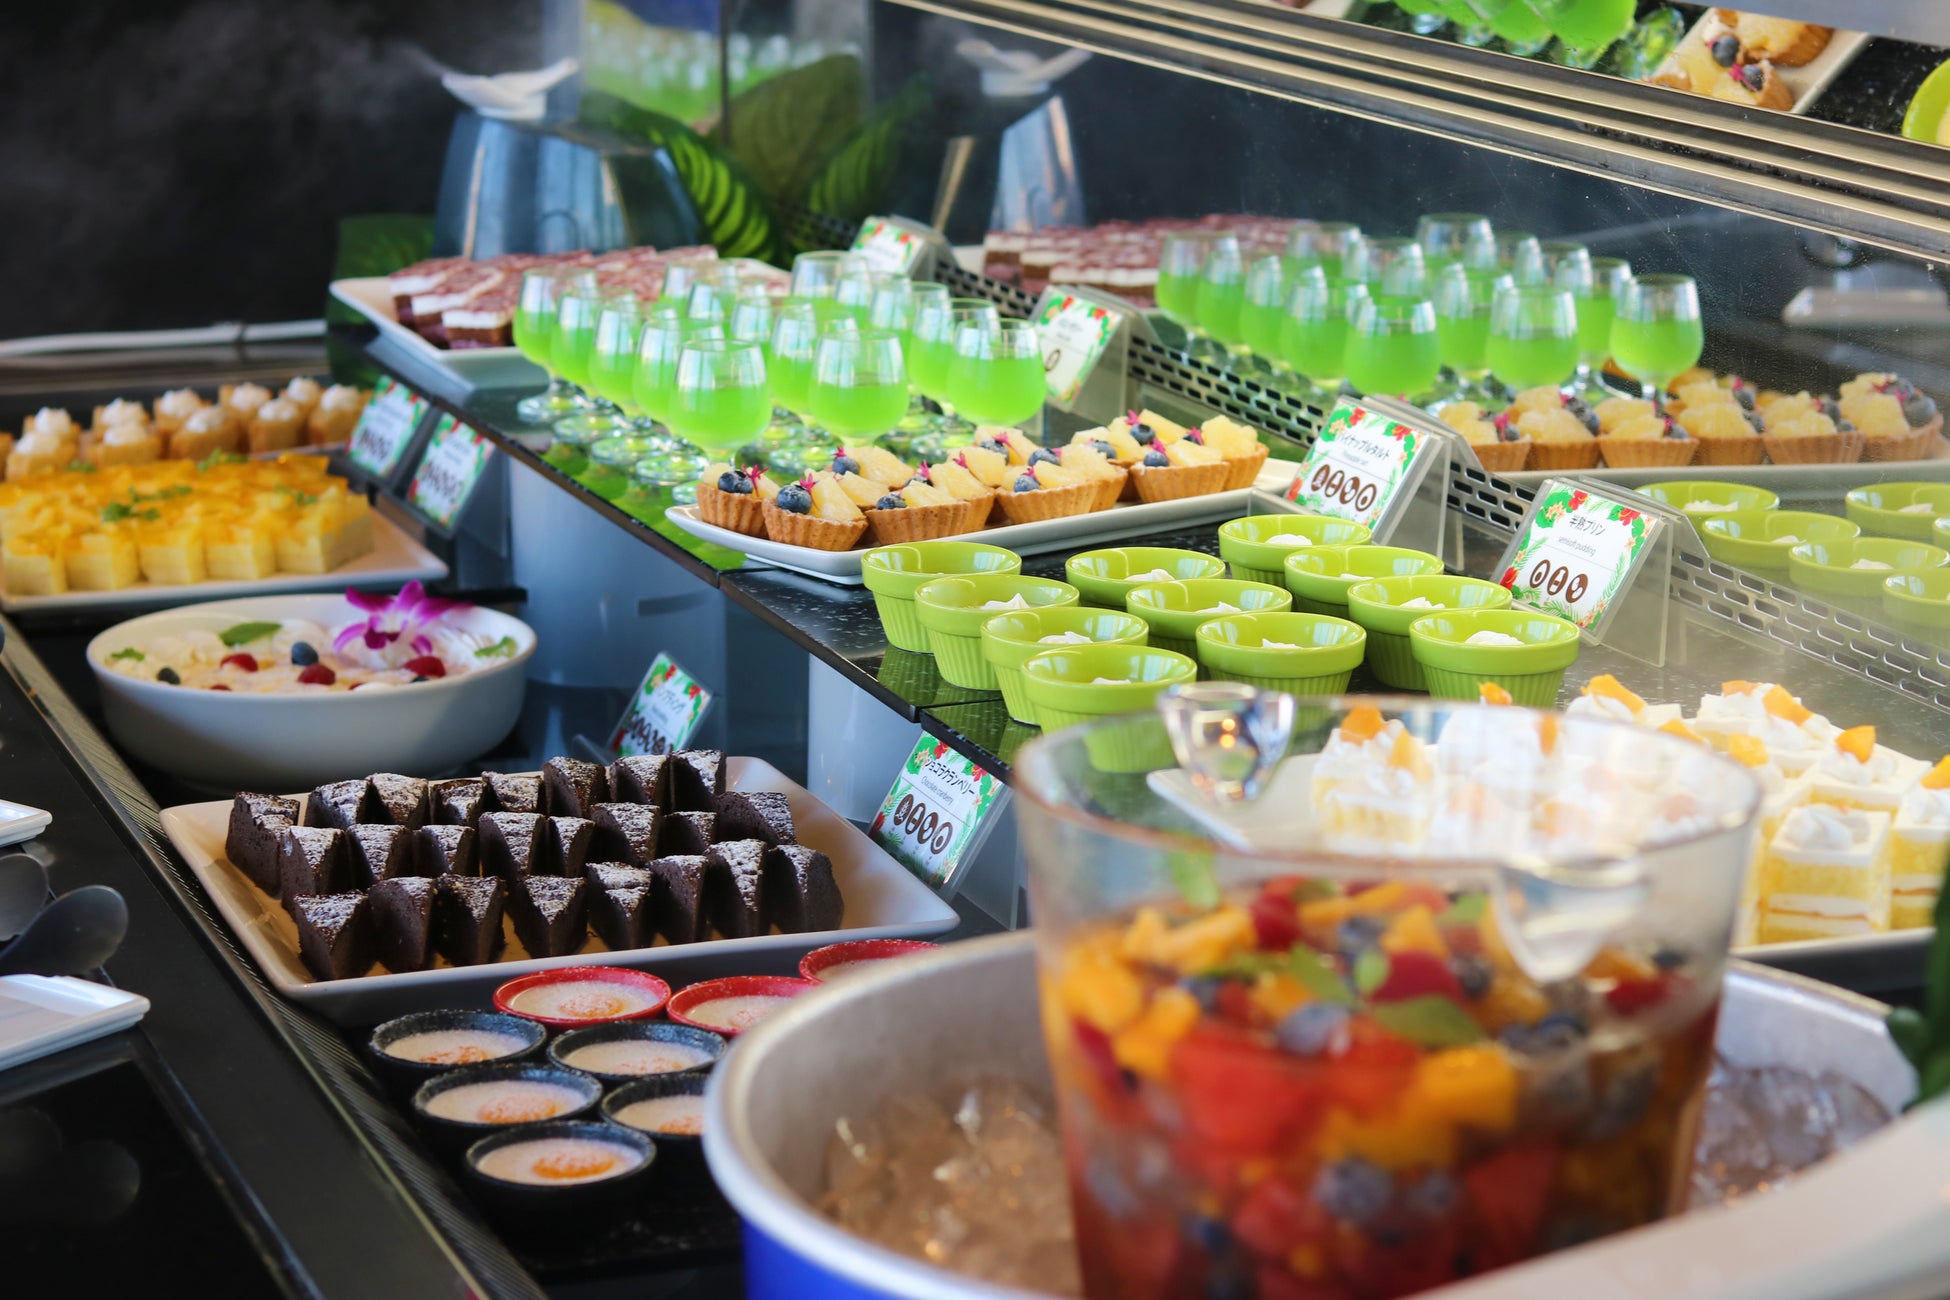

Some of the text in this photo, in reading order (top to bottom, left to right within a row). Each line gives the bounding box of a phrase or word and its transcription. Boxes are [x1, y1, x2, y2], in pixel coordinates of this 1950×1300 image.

[1570, 514, 1606, 536] 半熟プリン
[924, 755, 975, 795] ショコラクランベリー
